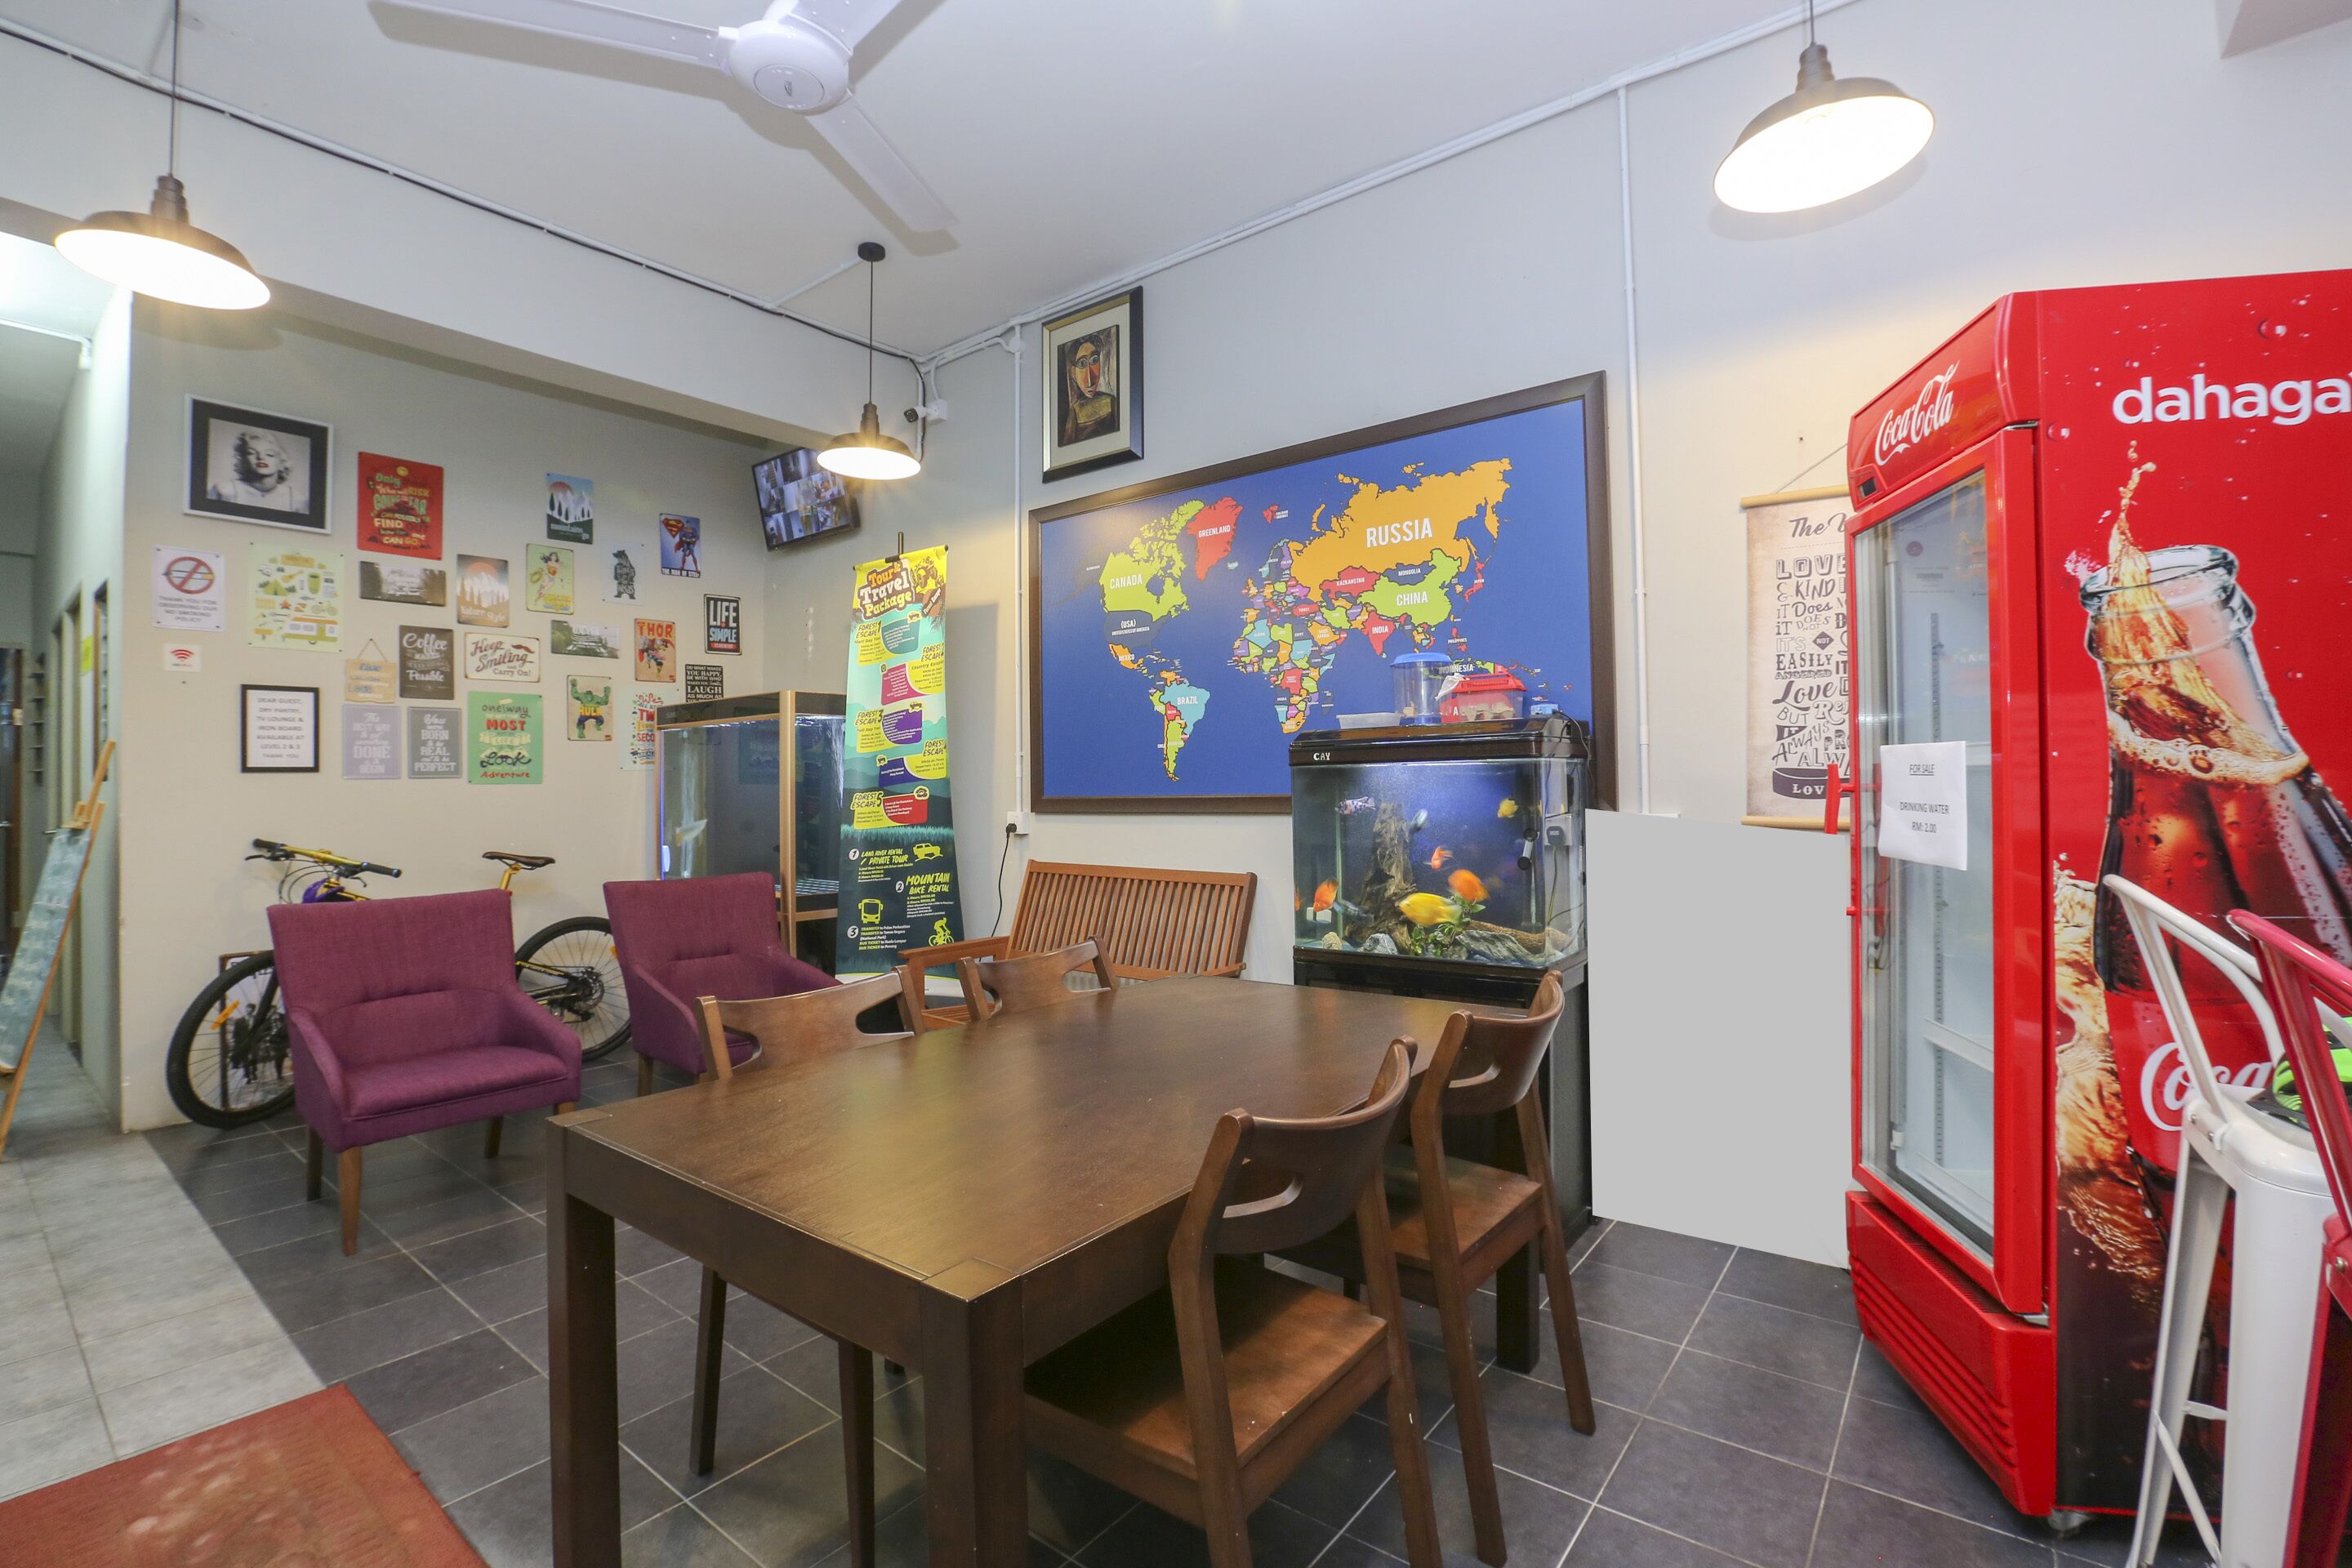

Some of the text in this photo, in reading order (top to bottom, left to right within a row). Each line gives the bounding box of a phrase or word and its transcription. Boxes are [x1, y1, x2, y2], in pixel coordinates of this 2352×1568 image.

[2113, 373, 2352, 425] dahaga
[1875, 360, 1959, 466] Coca-Cola
[373, 518, 403, 528] FIND
[1788, 517, 1828, 537] The
[1198, 524, 1231, 538] GREENLAND
[1366, 517, 1433, 548] RUSSIA
[1398, 568, 1421, 577] MONGOLIA
[1776, 553, 1846, 580] LOVE
[860, 571, 910, 604] Travel
[1110, 573, 1143, 590] CANADA
[1795, 578, 1835, 600] KIND
[865, 591, 912, 617] Package
[1396, 591, 1428, 606] CHINA
[709, 600, 737, 627] LIFE
[1792, 601, 1833, 617] Does
[858, 622, 878, 630] FOREST
[1120, 618, 1136, 629] (USA)
[1796, 613, 1831, 630] DOES
[637, 621, 674, 638] THOR
[709, 627, 737, 643] SIMPLE
[856, 630, 878, 638] ESCAPE
[1372, 626, 1388, 635] INDIA
[403, 633, 448, 654] Coffee
[470, 638, 505, 657] Keep
[923, 644, 942, 653] FOREST
[1776, 636, 1806, 653] IT'S
[475, 648, 535, 673] Smiling
[921, 653, 941, 662] ESCAPE
[1775, 653, 1833, 670] EASILY
[406, 670, 445, 681] Possible
[493, 668, 531, 677] Carry On!
[1775, 669, 1833, 680] ANGERED
[688, 685, 722, 693] LAUGH
[1177, 696, 1198, 705] BRAZIL
[1772, 680, 1837, 711] Love
[506, 706, 531, 719] way
[578, 706, 602, 715] HULK
[858, 709, 884, 723] FOREST 3
[1777, 706, 1809, 724] BUT
[353, 723, 373, 731] BEST
[485, 719, 527, 731] MOST
[855, 717, 877, 725] ESCAPE
[421, 729, 449, 740] BORN
[1783, 727, 1799, 737] IT
[924, 739, 944, 748] FOREST
[1771, 720, 1829, 765] ALWAYS
[354, 746, 390, 758] DONE
[421, 746, 450, 755] REAL
[923, 748, 943, 756] ESCAPE
[480, 751, 532, 768] Look
[414, 762, 457, 772] PERFECT
[1909, 764, 1935, 774] FOR SALE
[1792, 784, 1825, 795] LOV
[852, 800, 876, 808] ESCAPE
[876, 792, 883, 807] 5
[1900, 801, 1950, 815] DRINKING WATER
[1925, 822, 1937, 834] 2.00
[869, 856, 890, 865] PRIVATE
[892, 854, 908, 862] TOUR
[906, 872, 951, 885] MOUNTAIN
[909, 885, 925, 895] BIKE
[928, 884, 949, 893] RENTAL
